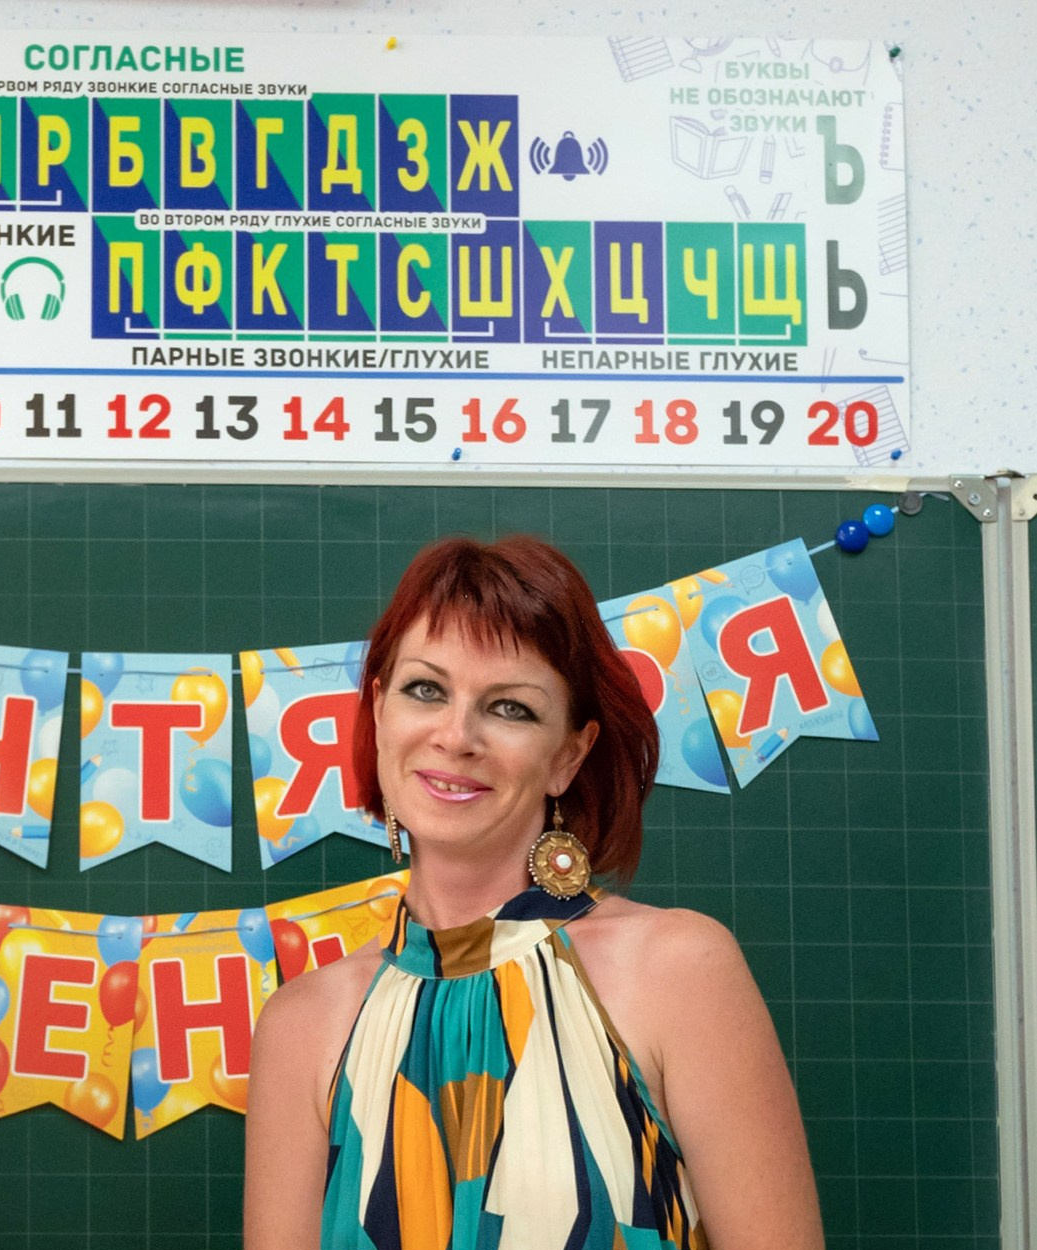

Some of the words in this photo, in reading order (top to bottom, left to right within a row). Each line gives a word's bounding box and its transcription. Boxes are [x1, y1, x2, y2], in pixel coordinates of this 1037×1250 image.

[24, 43, 245, 75] СОГЛАСНЫЕ
[725, 61, 810, 80] БУКВЫ
[43, 81, 83, 94] РЯДУ
[88, 82, 158, 94] ЗВОНКИЕ
[162, 83, 254, 95] СОГЛАСНЫЕ
[258, 84, 307, 96] ЗВУКИ
[669, 87, 700, 105] НЕ
[707, 88, 866, 107] ОБОЗНАЧАЮТ
[729, 115, 806, 133] ЗВУКИ
[38, 115, 71, 186] Р
[108, 116, 144, 187] Б
[180, 117, 216, 188] В
[255, 118, 284, 189] Г
[321, 115, 362, 194] Д
[397, 118, 429, 192] З
[458, 121, 513, 192] Ж
[815, 114, 866, 205] Ъ
[139, 213, 161, 226] ВО
[164, 213, 225, 227] ВТОРОМ
[229, 214, 270, 228] РЯДУ
[274, 214, 331, 228] ГЛУХИЕ
[335, 215, 428, 229] СОГЛАСНЫЕ
[431, 216, 482, 229] ЗВУКИ
[108, 242, 144, 314] П
[174, 242, 223, 315] Ф
[252, 243, 288, 315] К
[325, 244, 359, 316] Т
[396, 243, 431, 318] С
[459, 246, 513, 317] Ш
[541, 246, 575, 319] Х
[609, 242, 649, 324] Ц
[683, 248, 718, 320] Ч
[743, 243, 802, 326] Щ
[825, 239, 868, 331] Ь
[132, 346, 245, 368] ПАРНЫЕ
[253, 347, 490, 370] ЗВОНКИЕ/ГЛУХИЕ
[542, 349, 690, 371] НЕПАРНЫЕ
[699, 351, 799, 372] ГЛУХИЕ
[24, 393, 82, 438] 11
[107, 393, 172, 440] 12
[195, 395, 259, 441] 13
[282, 395, 351, 441] 14
[374, 397, 437, 443] 15
[461, 397, 527, 444] 16
[550, 398, 612, 443] 17
[635, 399, 700, 445] 18
[722, 400, 786, 445] 19
[807, 400, 879, 447] 20
